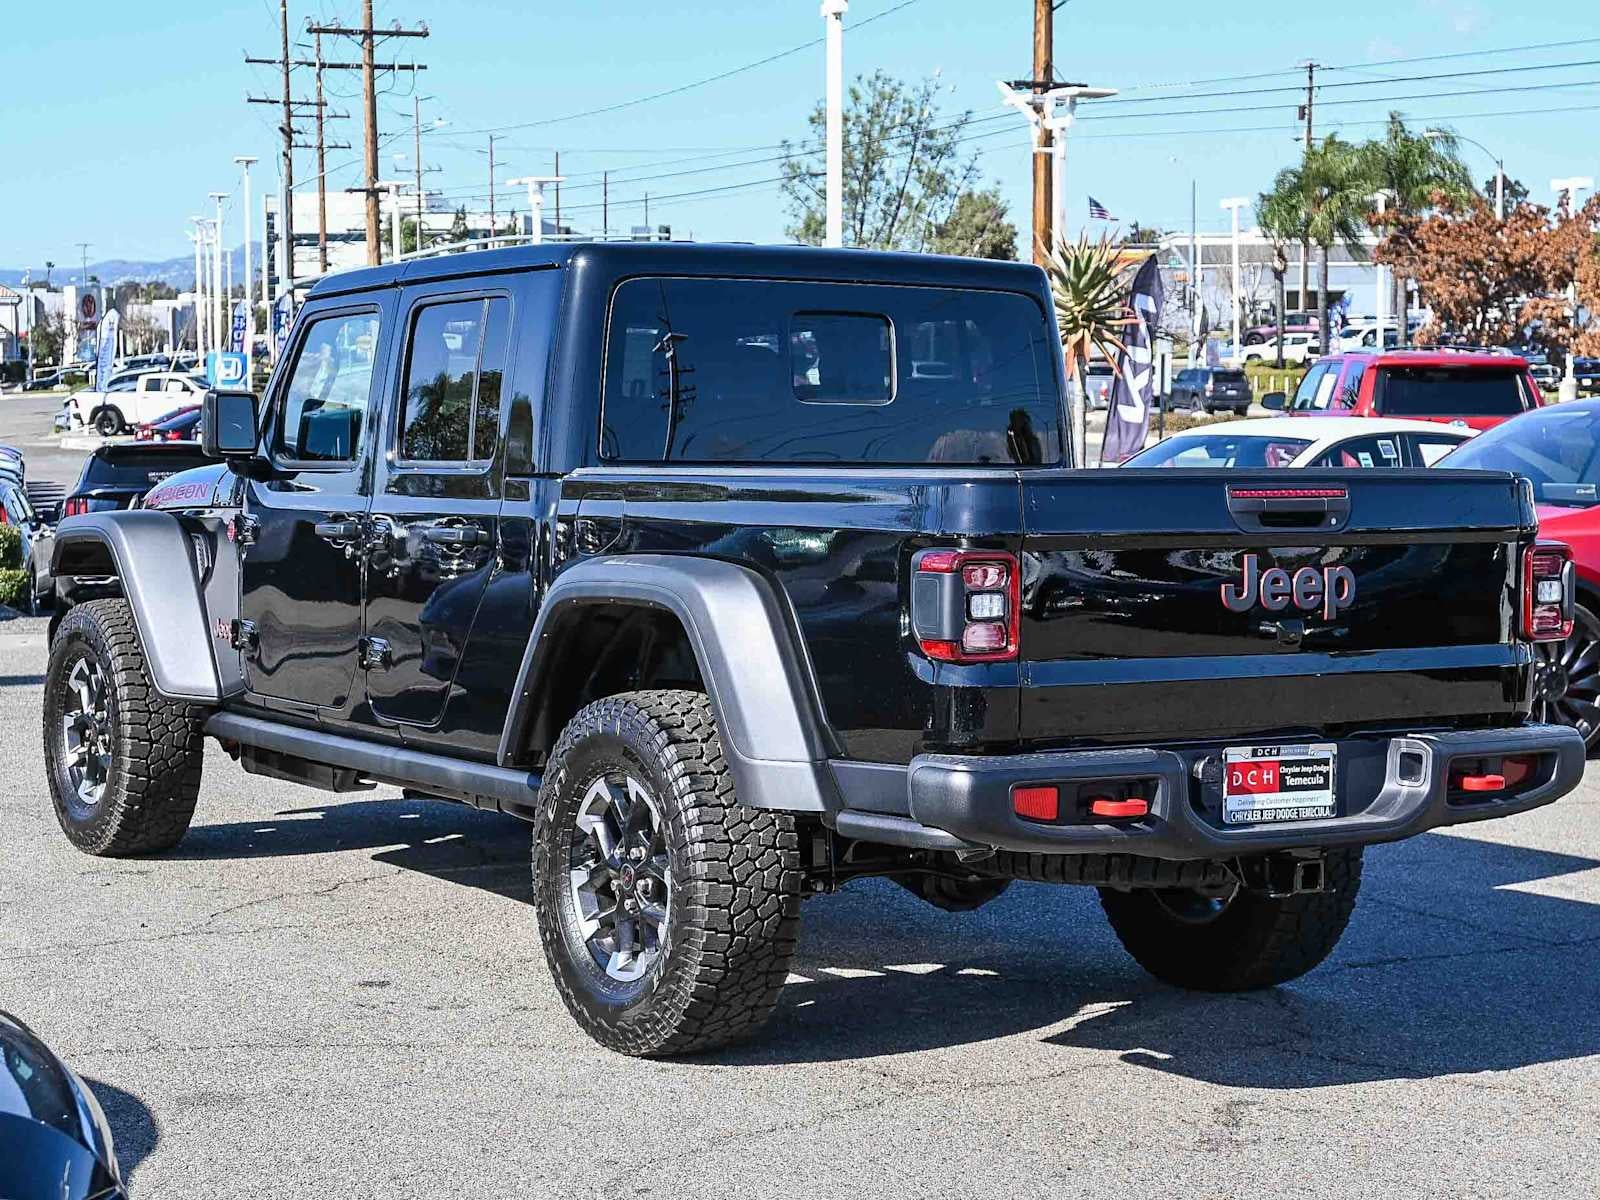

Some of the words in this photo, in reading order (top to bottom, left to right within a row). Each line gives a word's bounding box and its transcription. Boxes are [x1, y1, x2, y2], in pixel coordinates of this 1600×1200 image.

[1220, 553, 1357, 621] Jeep
[1279, 766, 1301, 774] Chrysler
[1301, 765, 1313, 774] Jeep
[1313, 764, 1330, 772] Dodge
[1284, 774, 1324, 786] Temecula
[1231, 810, 1261, 822] CHRYSLER
[1262, 809, 1276, 821] JEEP
[1276, 808, 1298, 819] DODGE
[1298, 806, 1331, 818] TEMECULA
